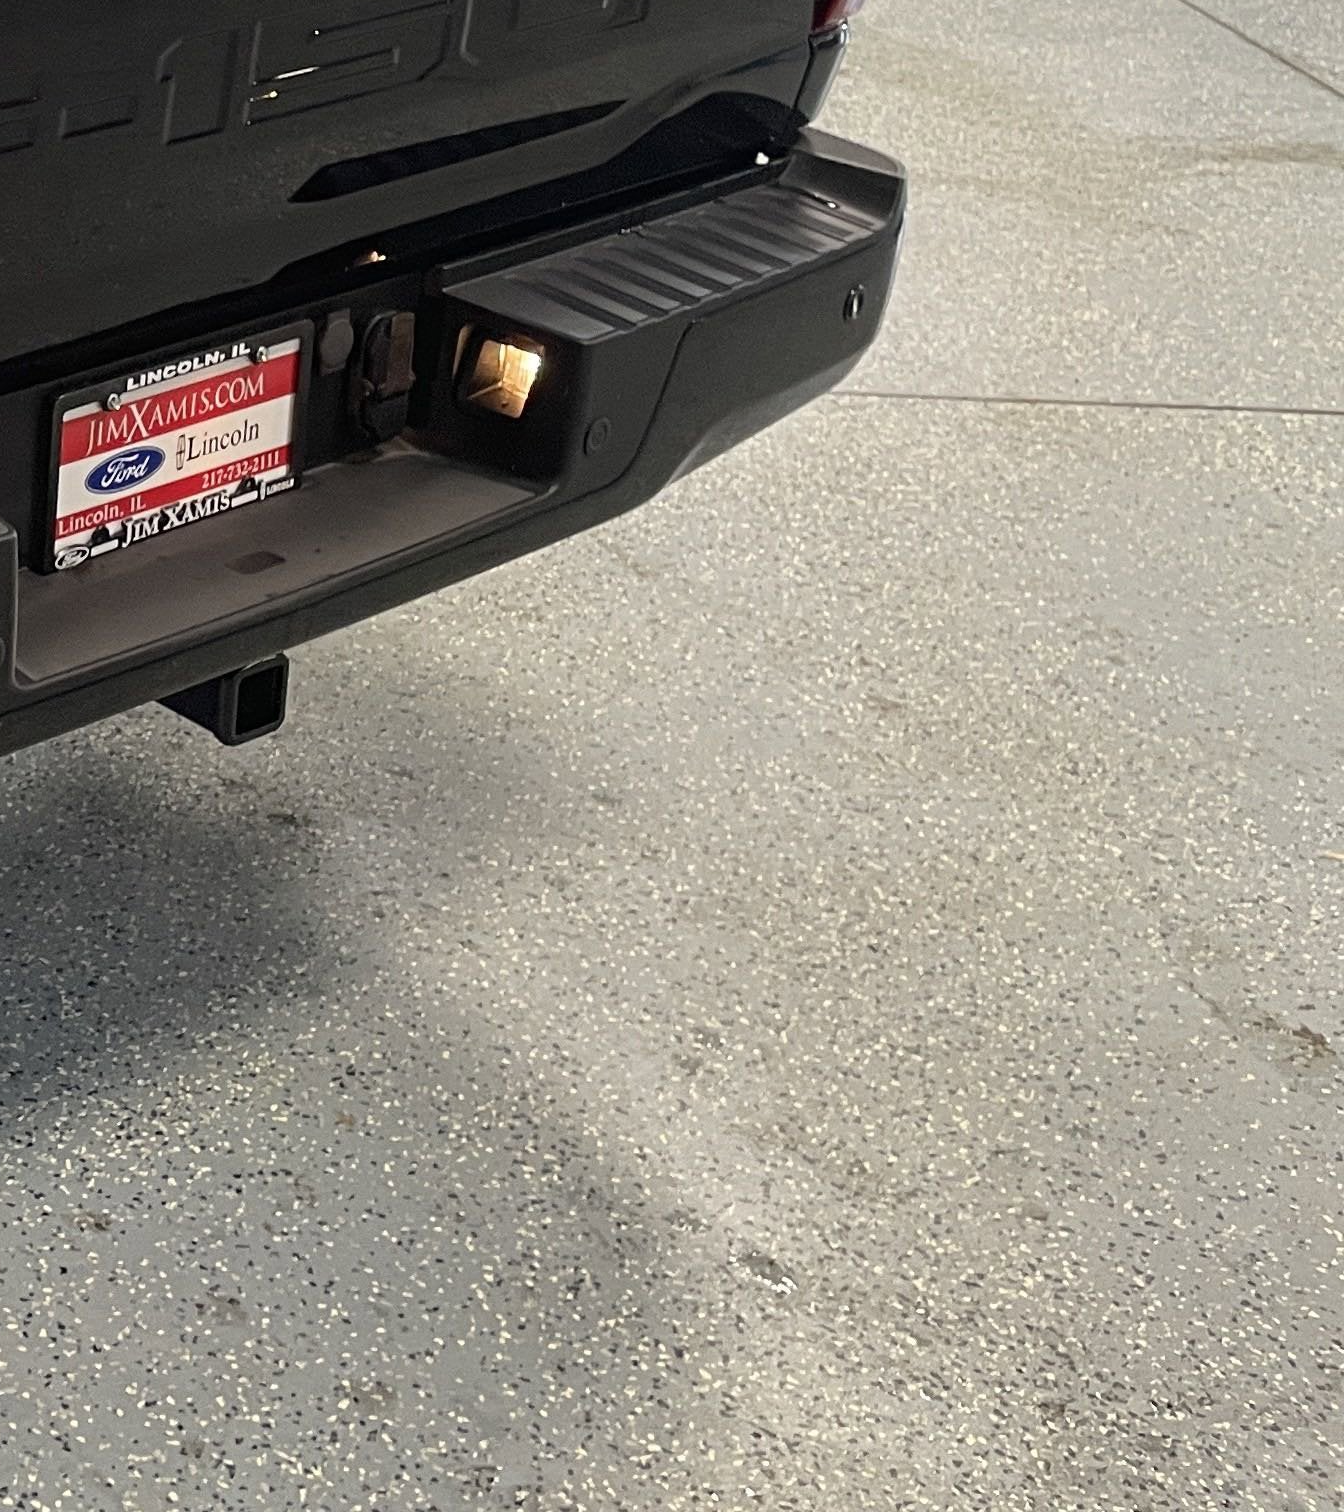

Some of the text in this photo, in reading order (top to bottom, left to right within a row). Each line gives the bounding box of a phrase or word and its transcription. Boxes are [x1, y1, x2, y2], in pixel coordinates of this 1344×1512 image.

[126, 342, 251, 391] LINCOLN, IL
[85, 372, 265, 456] JIMXAMIS.COM
[186, 419, 260, 462] Lincoln
[100, 453, 149, 488] Ford
[121, 490, 231, 548] JIM XAMIS
[130, 495, 147, 513] IL
